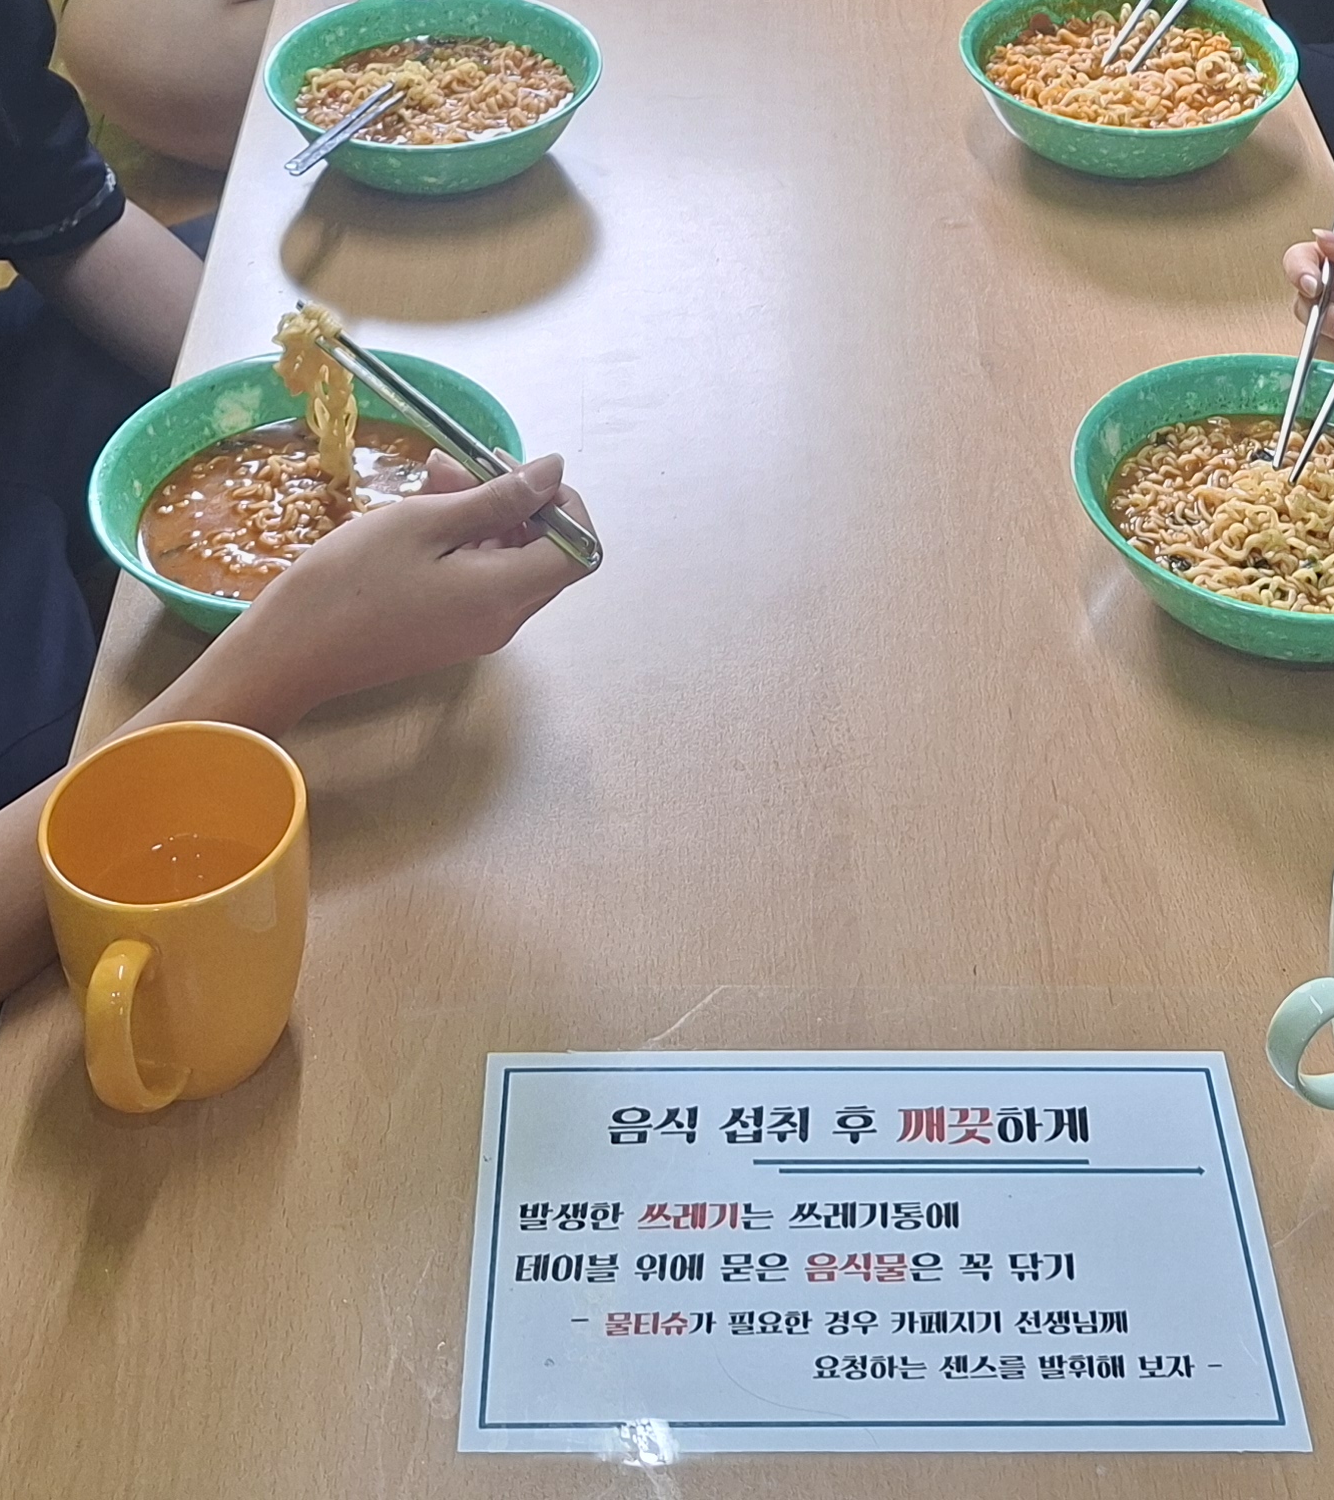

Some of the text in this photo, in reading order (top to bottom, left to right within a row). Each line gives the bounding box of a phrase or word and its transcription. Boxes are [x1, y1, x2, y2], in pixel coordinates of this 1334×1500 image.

[606, 1104, 1090, 1146] 음식 섭취 후 깨끗하게
[518, 1200, 960, 1232] 발생한 쓰레기는 쓰레기통에
[514, 1251, 1076, 1284] 테이블 위에 묻은 음식물은 꼭 닦기
[605, 1310, 718, 1337] 물티슈가
[727, 1309, 814, 1337] 필요한
[824, 1309, 880, 1337] 경우
[889, 1309, 1003, 1335] 카페지기
[1013, 1309, 1129, 1336] 선생님께
[812, 1353, 928, 1382] 요청하는
[938, 1353, 1027, 1381] 센스를
[1037, 1353, 1126, 1381] 발휘해
[1137, 1353, 1197, 1380] 보자
